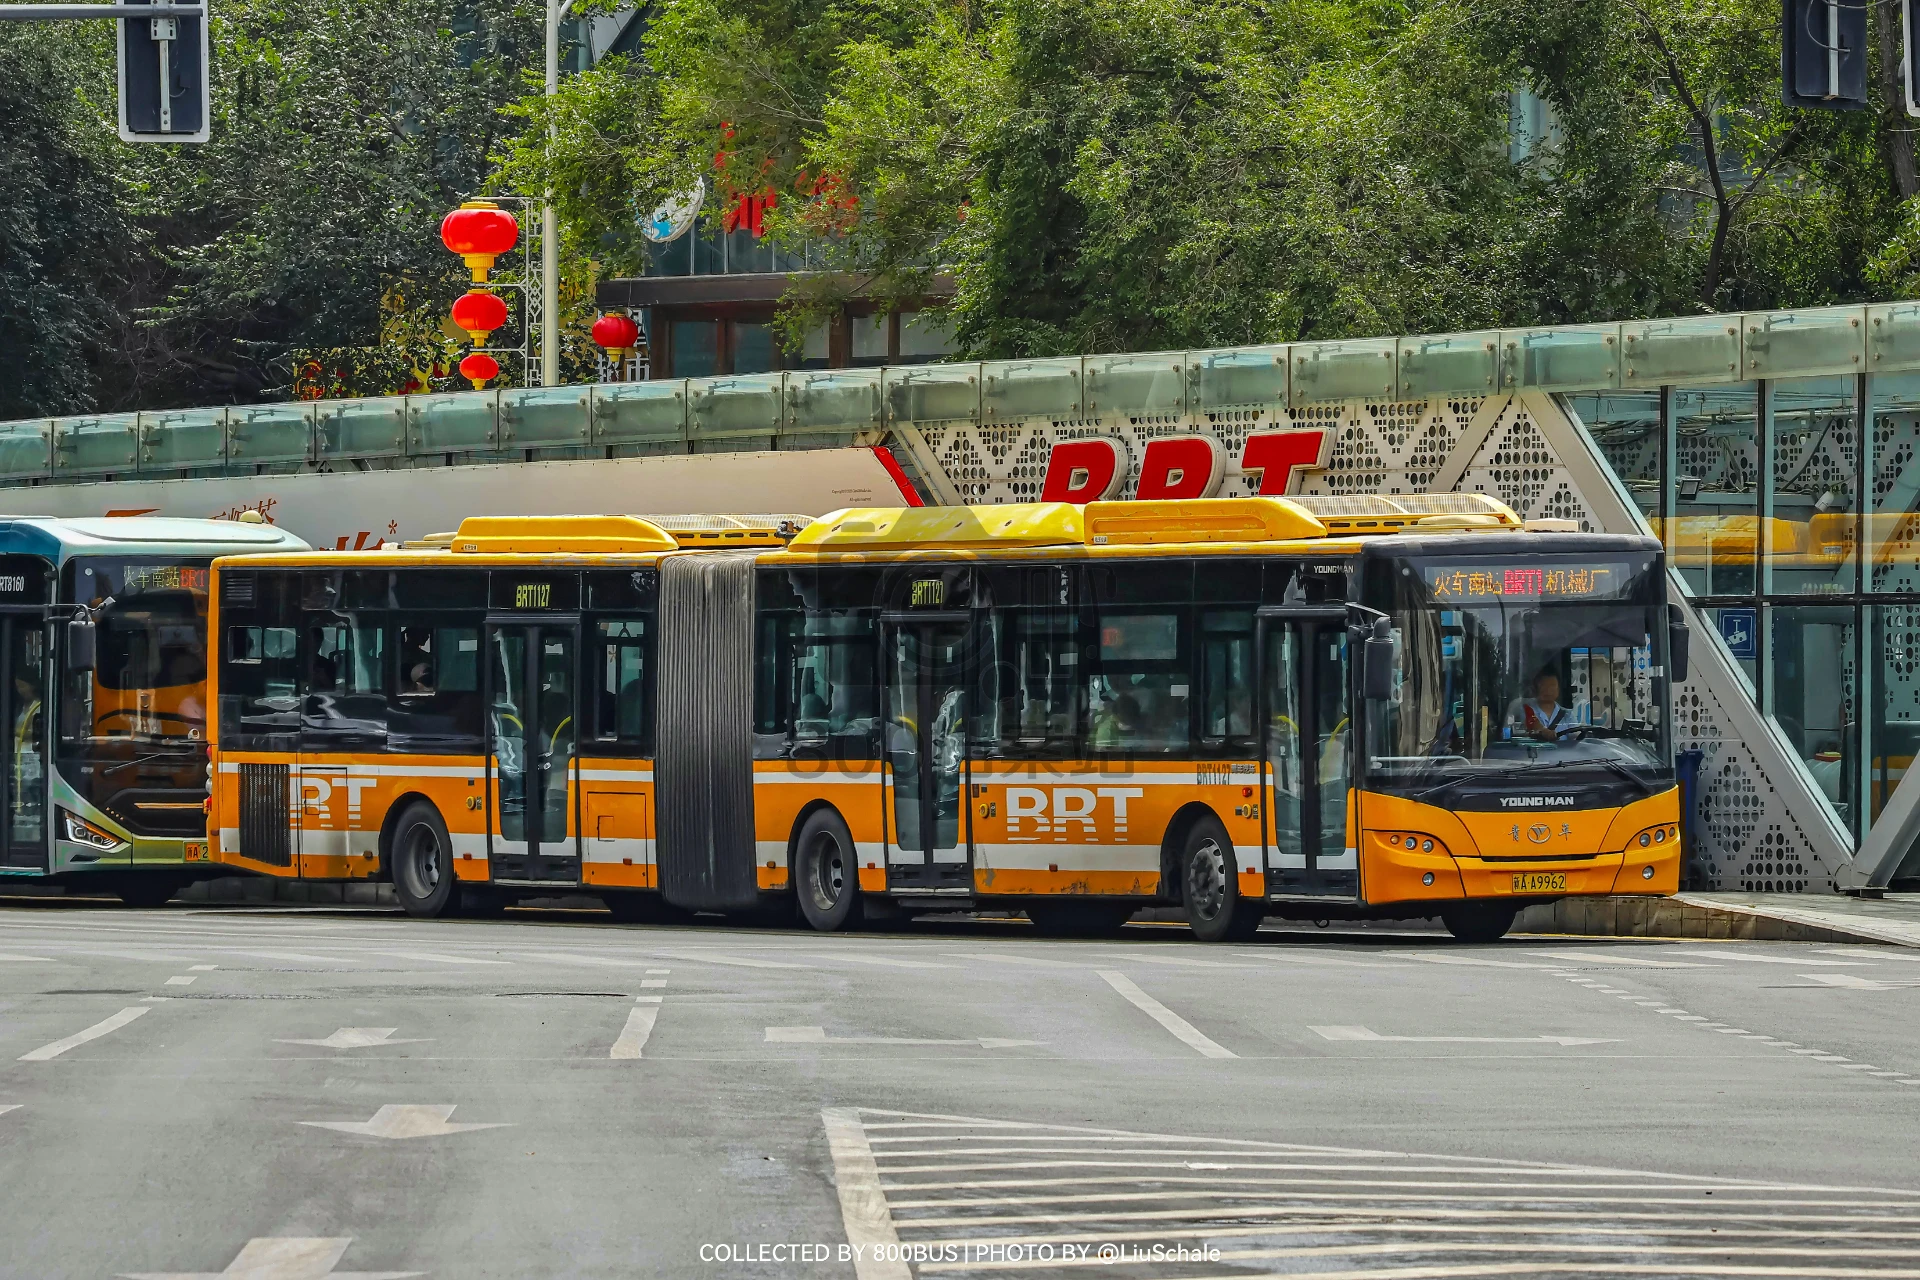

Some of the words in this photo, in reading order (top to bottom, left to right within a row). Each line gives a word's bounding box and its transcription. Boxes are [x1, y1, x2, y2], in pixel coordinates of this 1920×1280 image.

[515, 584, 550, 607] BRT1127
[911, 580, 944, 605] BRT1127
[1196, 763, 1231, 785] BRT1127
[289, 777, 378, 828] RT
[1005, 787, 1144, 842] BRT
